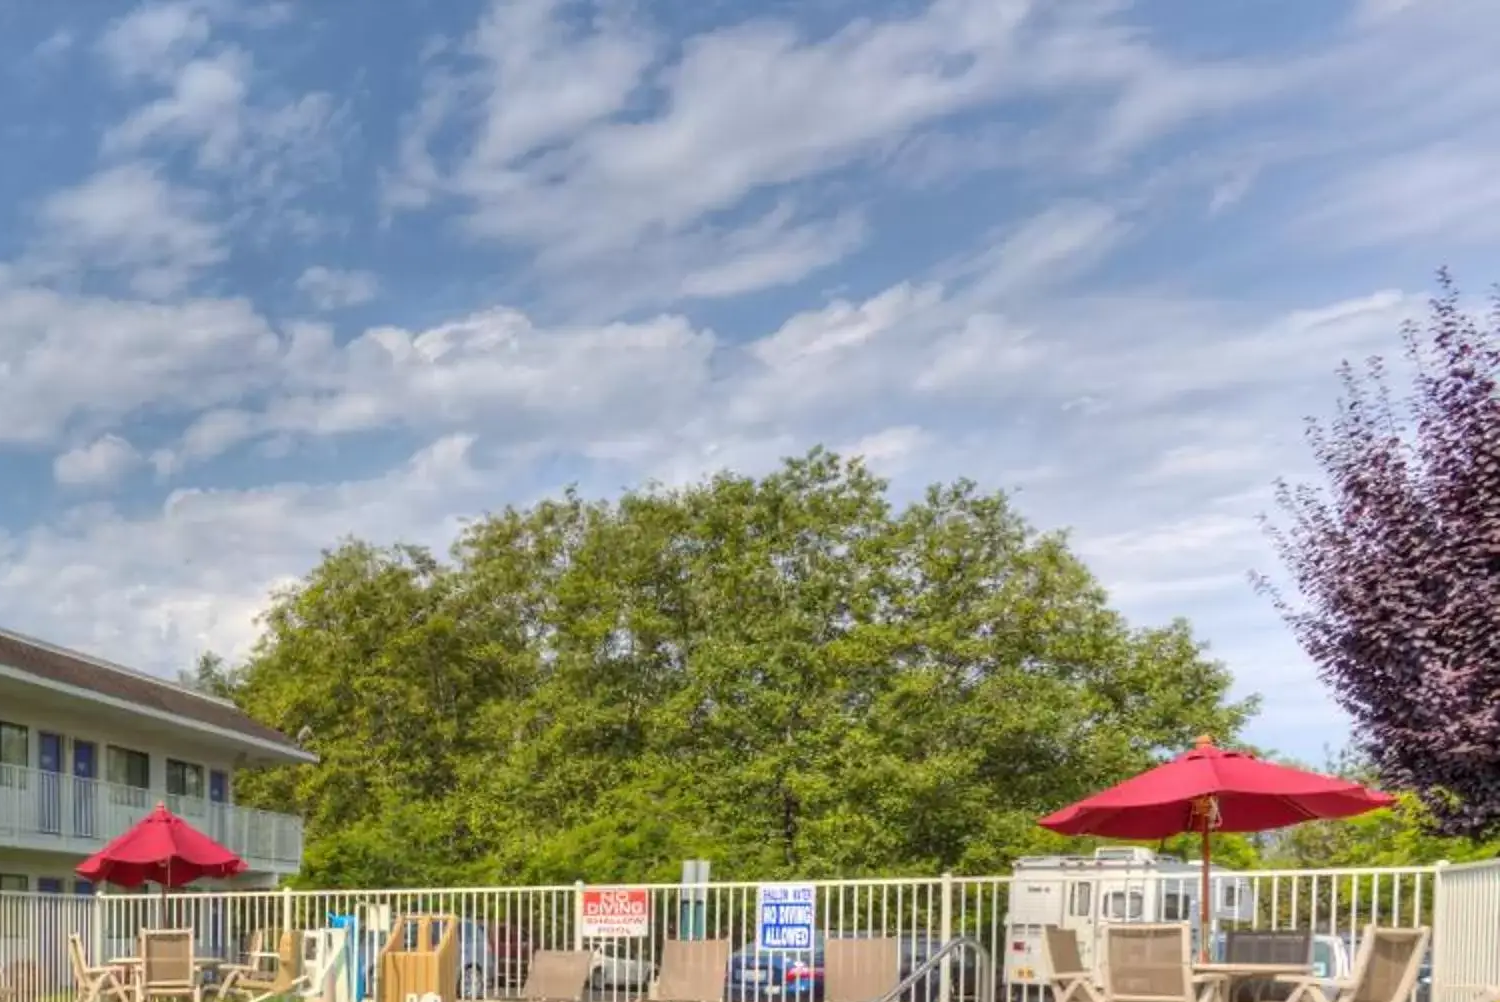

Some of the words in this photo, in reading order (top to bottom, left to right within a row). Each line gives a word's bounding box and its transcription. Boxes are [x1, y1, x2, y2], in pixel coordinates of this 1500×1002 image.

[600, 890, 629, 902] NO
[587, 902, 644, 915] DIVING
[763, 906, 776, 923] NO
[779, 905, 813, 923] DIVING
[765, 926, 809, 946] ALLOWED
